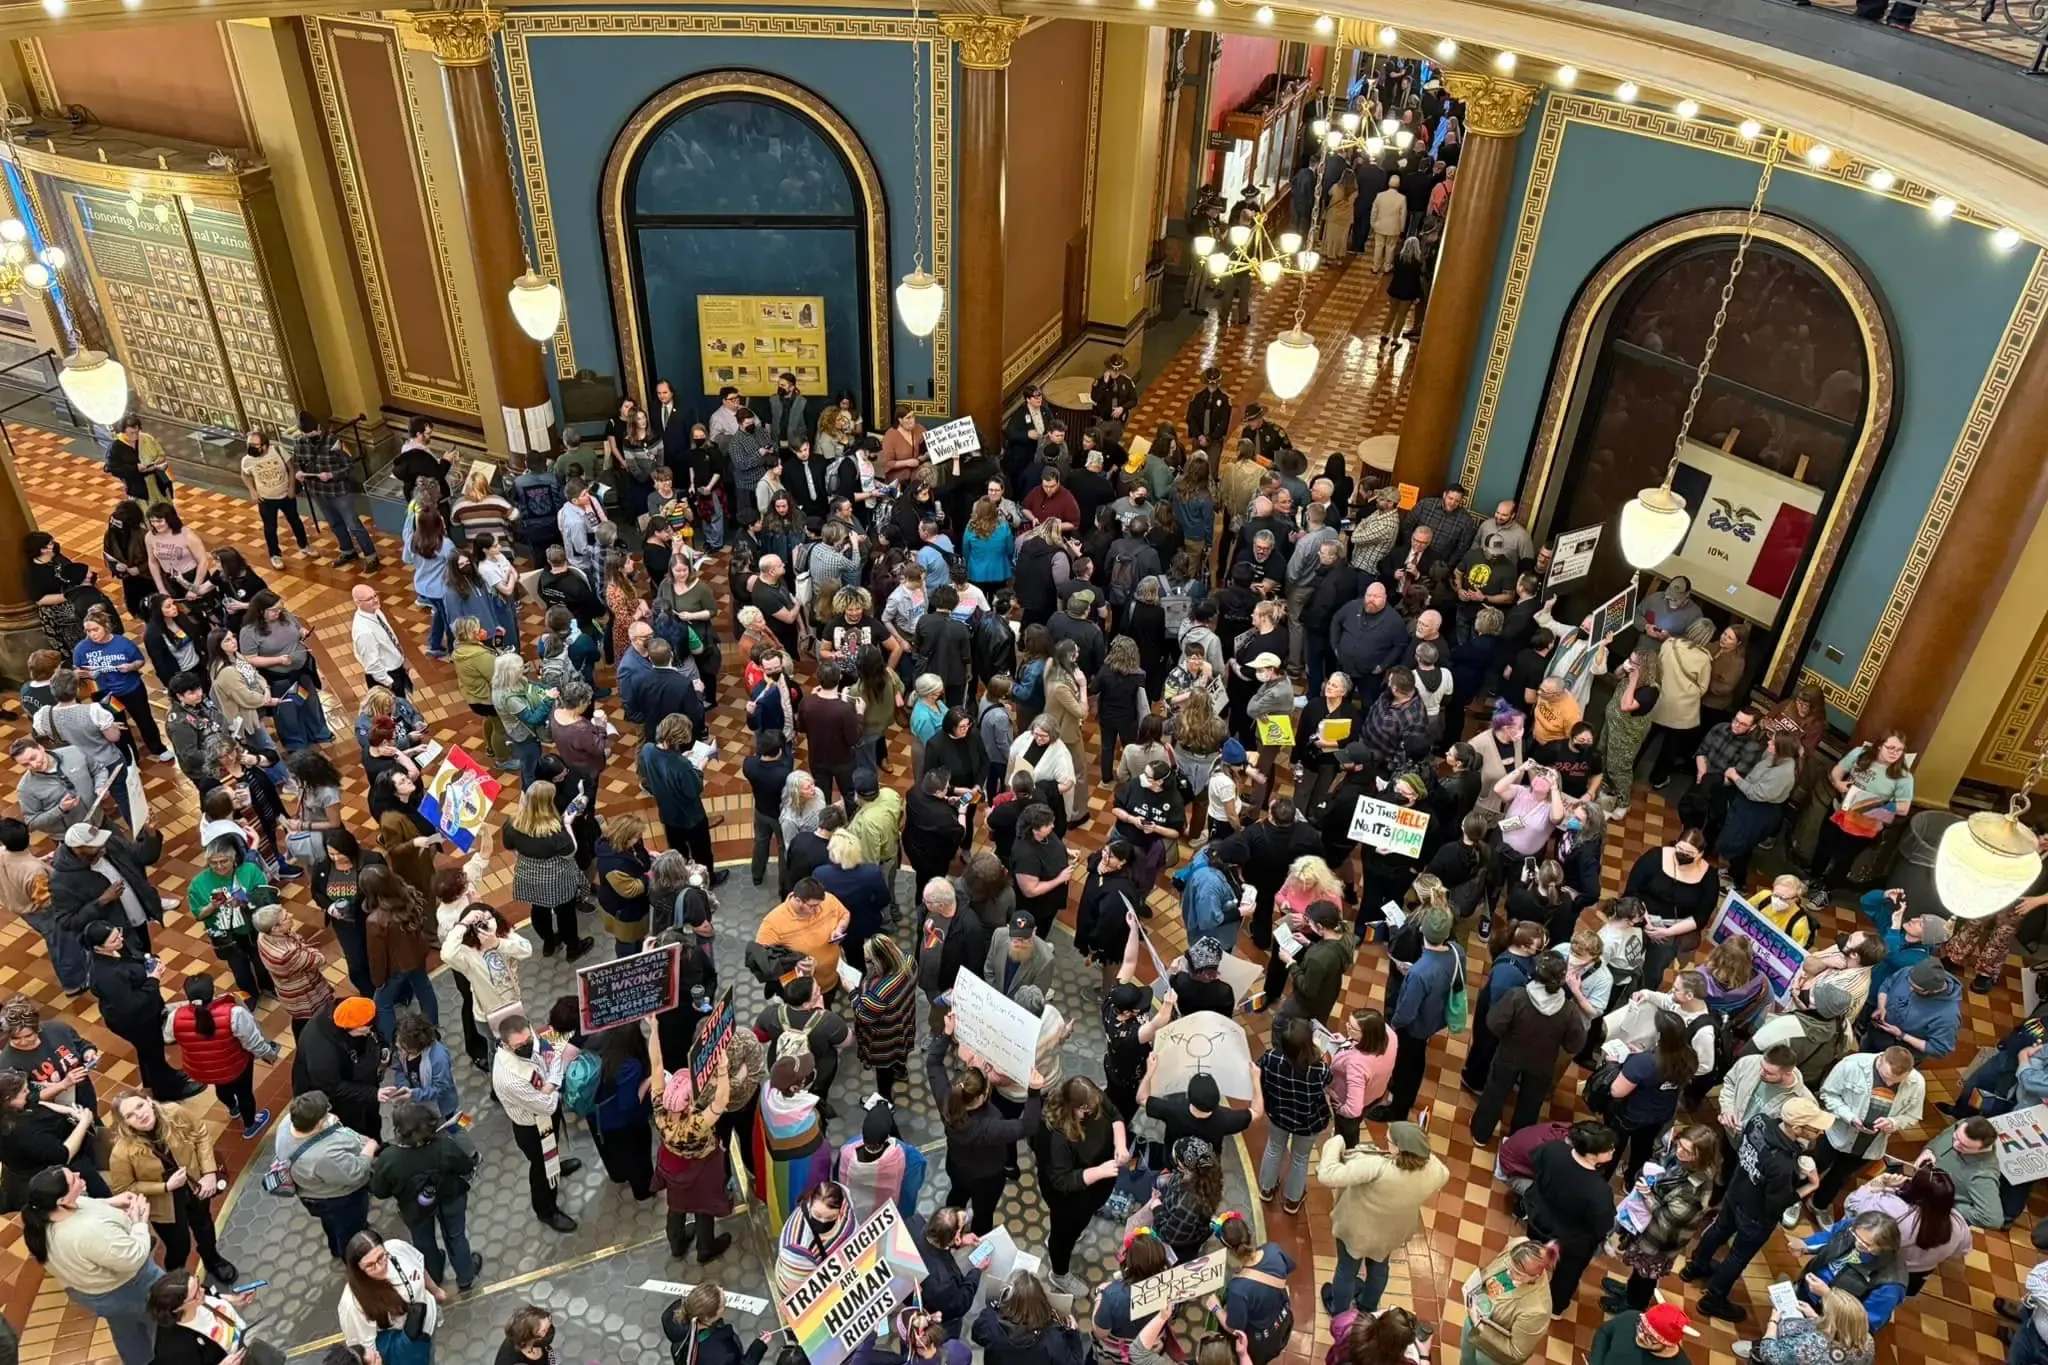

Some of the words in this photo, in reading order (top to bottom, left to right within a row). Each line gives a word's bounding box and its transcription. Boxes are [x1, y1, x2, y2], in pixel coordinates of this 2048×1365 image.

[1708, 546, 1729, 561] IOWA
[86, 650, 102, 660] NOT
[1361, 800, 1374, 815] IS
[1396, 808, 1428, 829] HELL?
[1389, 827, 1422, 846] IOWA
[587, 967, 612, 980] EVEN
[615, 962, 633, 971] OUR
[634, 951, 669, 966] STATE
[591, 974, 620, 985] MOTTO
[623, 966, 650, 977] KNOWS
[598, 985, 607, 994] IS
[701, 1000, 725, 1046] STOP
[785, 1257, 843, 1318] TRANS
[843, 1208, 895, 1262] RIGHTS
[839, 1267, 860, 1291] ARE
[1131, 1270, 1174, 1294] YOU
[1132, 1263, 1223, 1309] REPRESENT
[824, 1260, 892, 1334] HUMAN
[842, 1291, 894, 1348] RIGHTS
